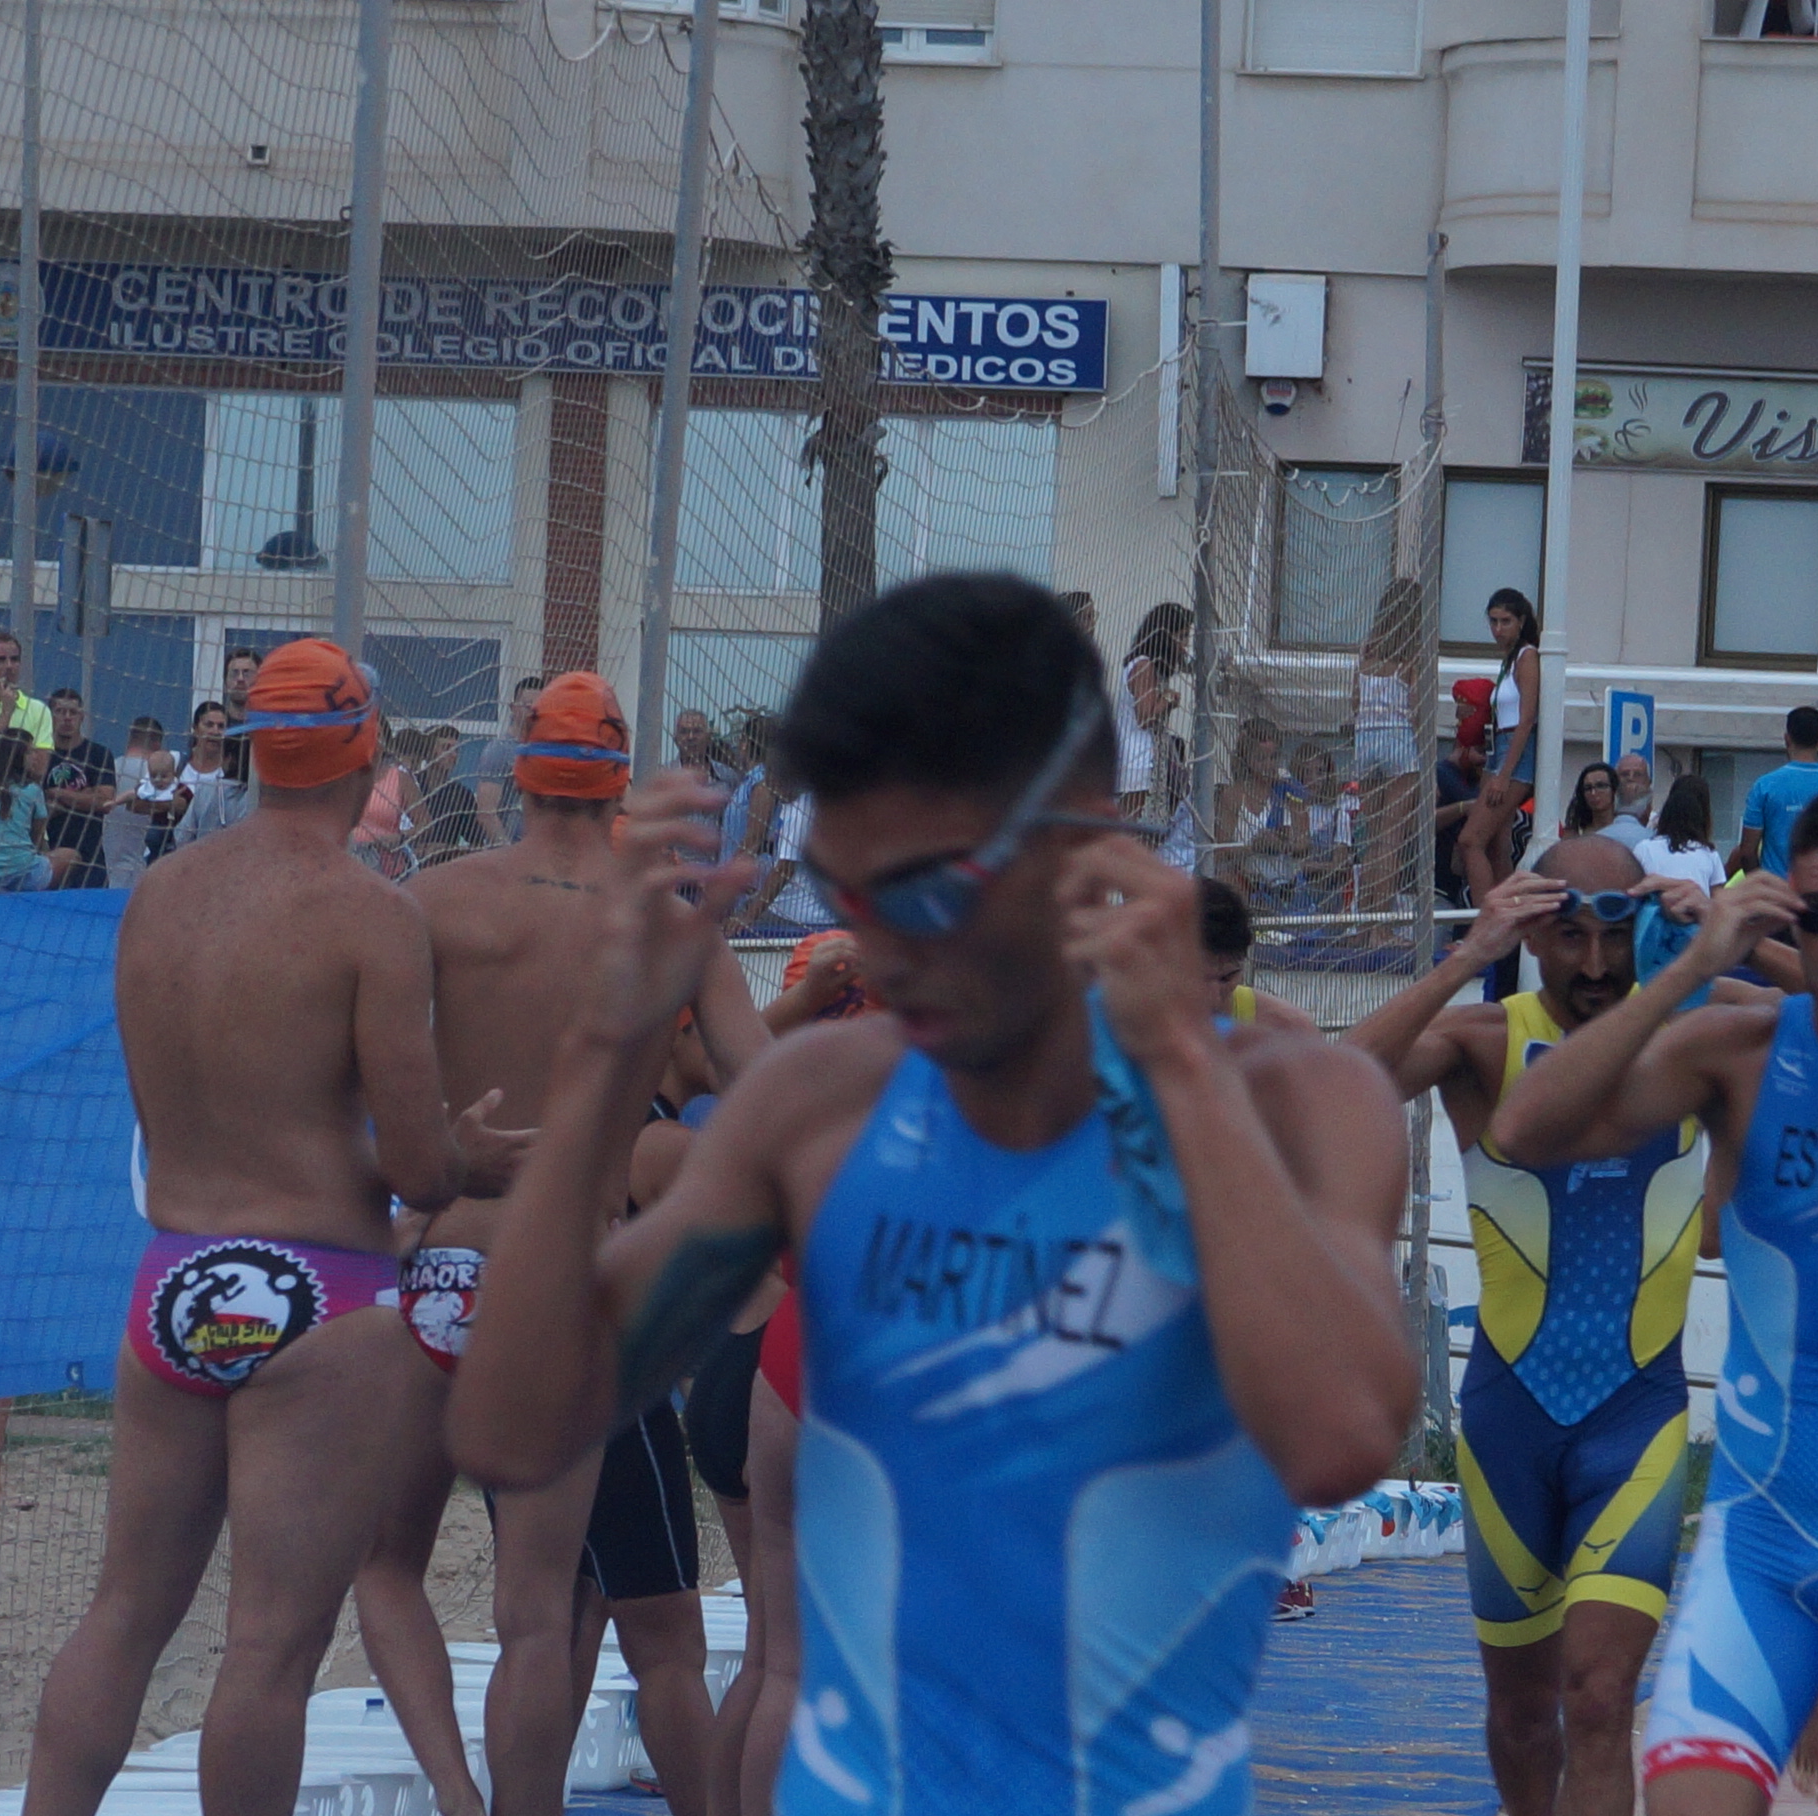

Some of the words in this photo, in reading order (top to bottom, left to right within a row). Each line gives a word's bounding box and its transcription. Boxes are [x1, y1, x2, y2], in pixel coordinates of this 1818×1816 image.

[381, 281, 465, 325] DE
[483, 284, 1080, 349] RECOOCIENTOS
[110, 321, 312, 355] ILUSTRE
[565, 339, 758, 372] OFICAL
[1621, 702, 1648, 758] P
